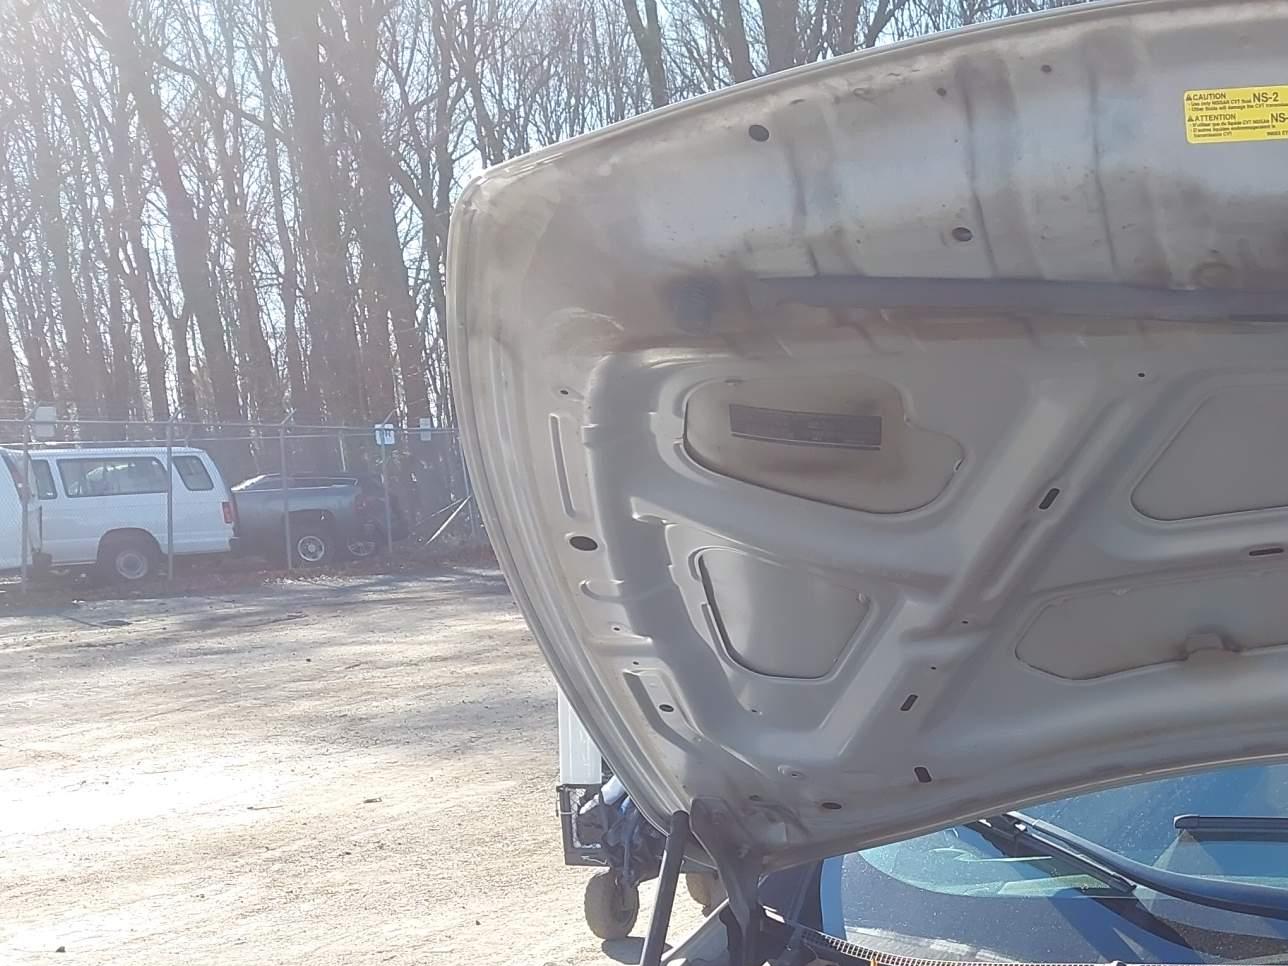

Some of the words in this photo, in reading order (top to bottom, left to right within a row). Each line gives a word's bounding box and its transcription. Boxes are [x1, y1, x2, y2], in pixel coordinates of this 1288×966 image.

[1193, 93, 1227, 101] CAUTION
[1253, 91, 1279, 103] NS-2
[1195, 113, 1236, 122] ATTENTION
